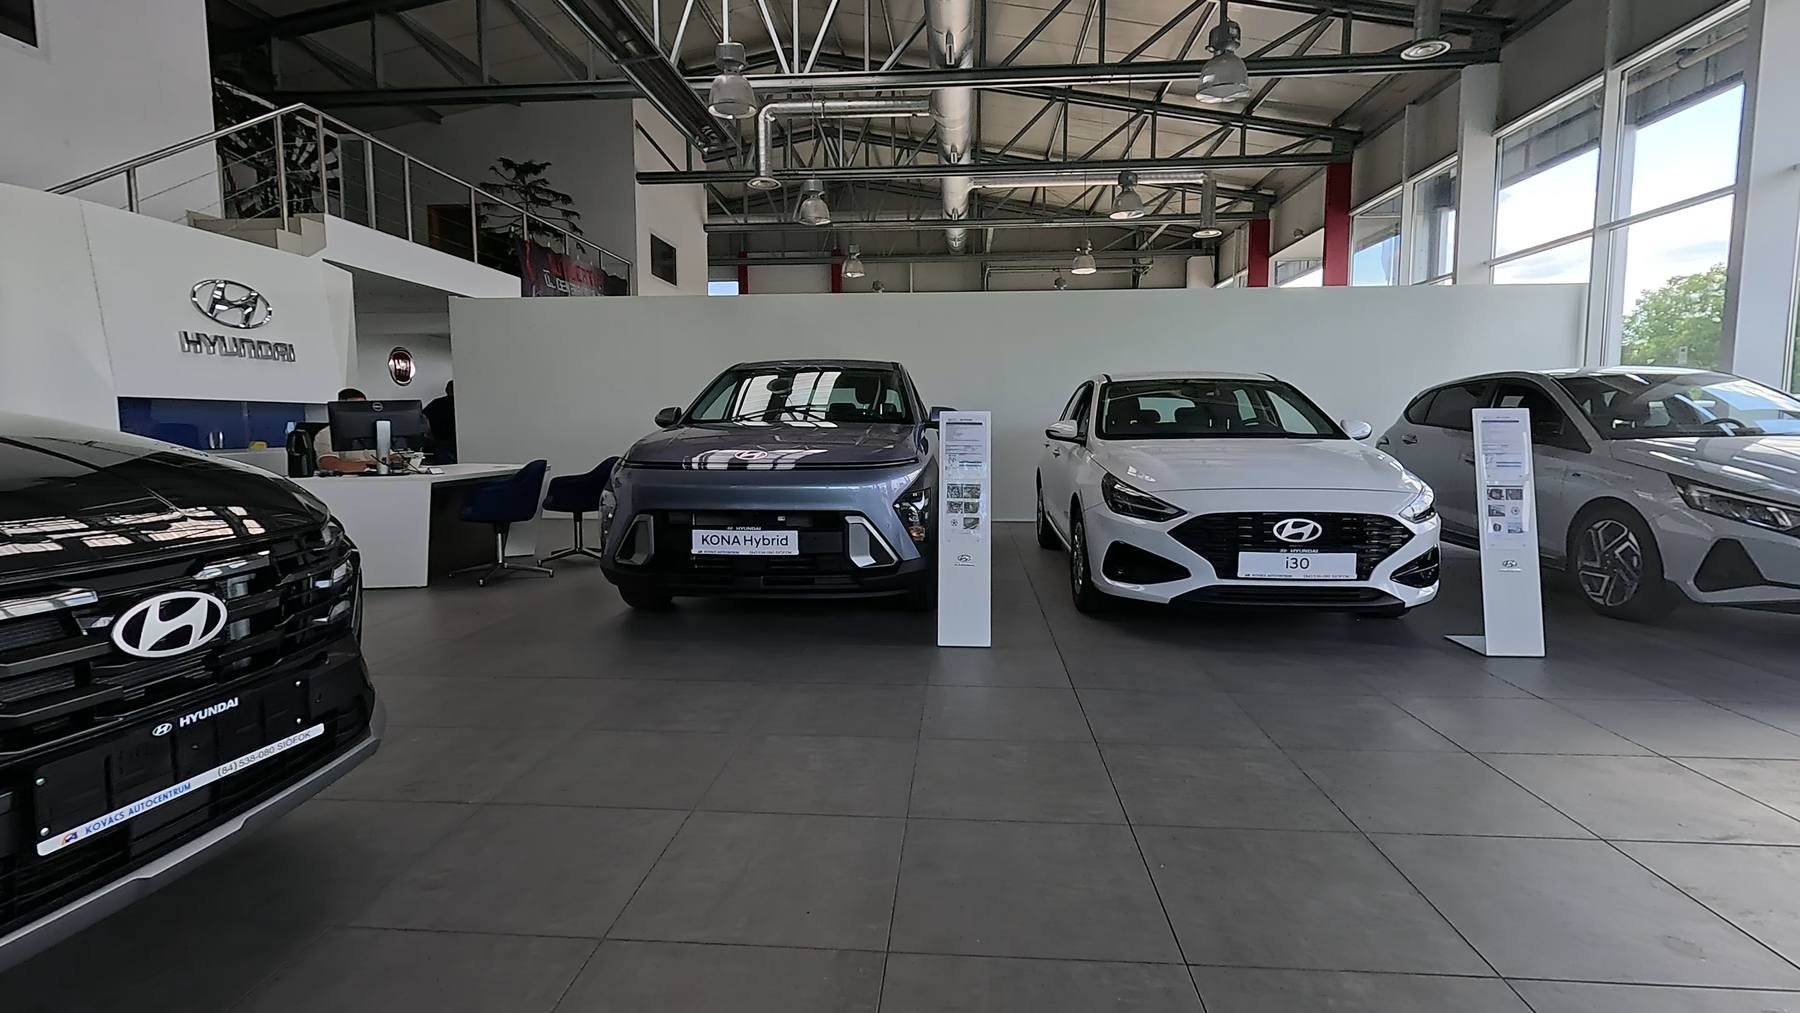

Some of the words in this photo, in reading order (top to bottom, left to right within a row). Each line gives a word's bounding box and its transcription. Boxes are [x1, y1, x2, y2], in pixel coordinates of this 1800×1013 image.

[178, 330, 296, 362] HYUNDAI
[701, 534, 741, 546] KONA
[743, 534, 789, 548] Hybrid
[1285, 556, 1310, 569] i30
[179, 697, 239, 728] HYUNDAI
[85, 811, 125, 835] KOVACS
[128, 782, 191, 816] AUTOCENTRUM
